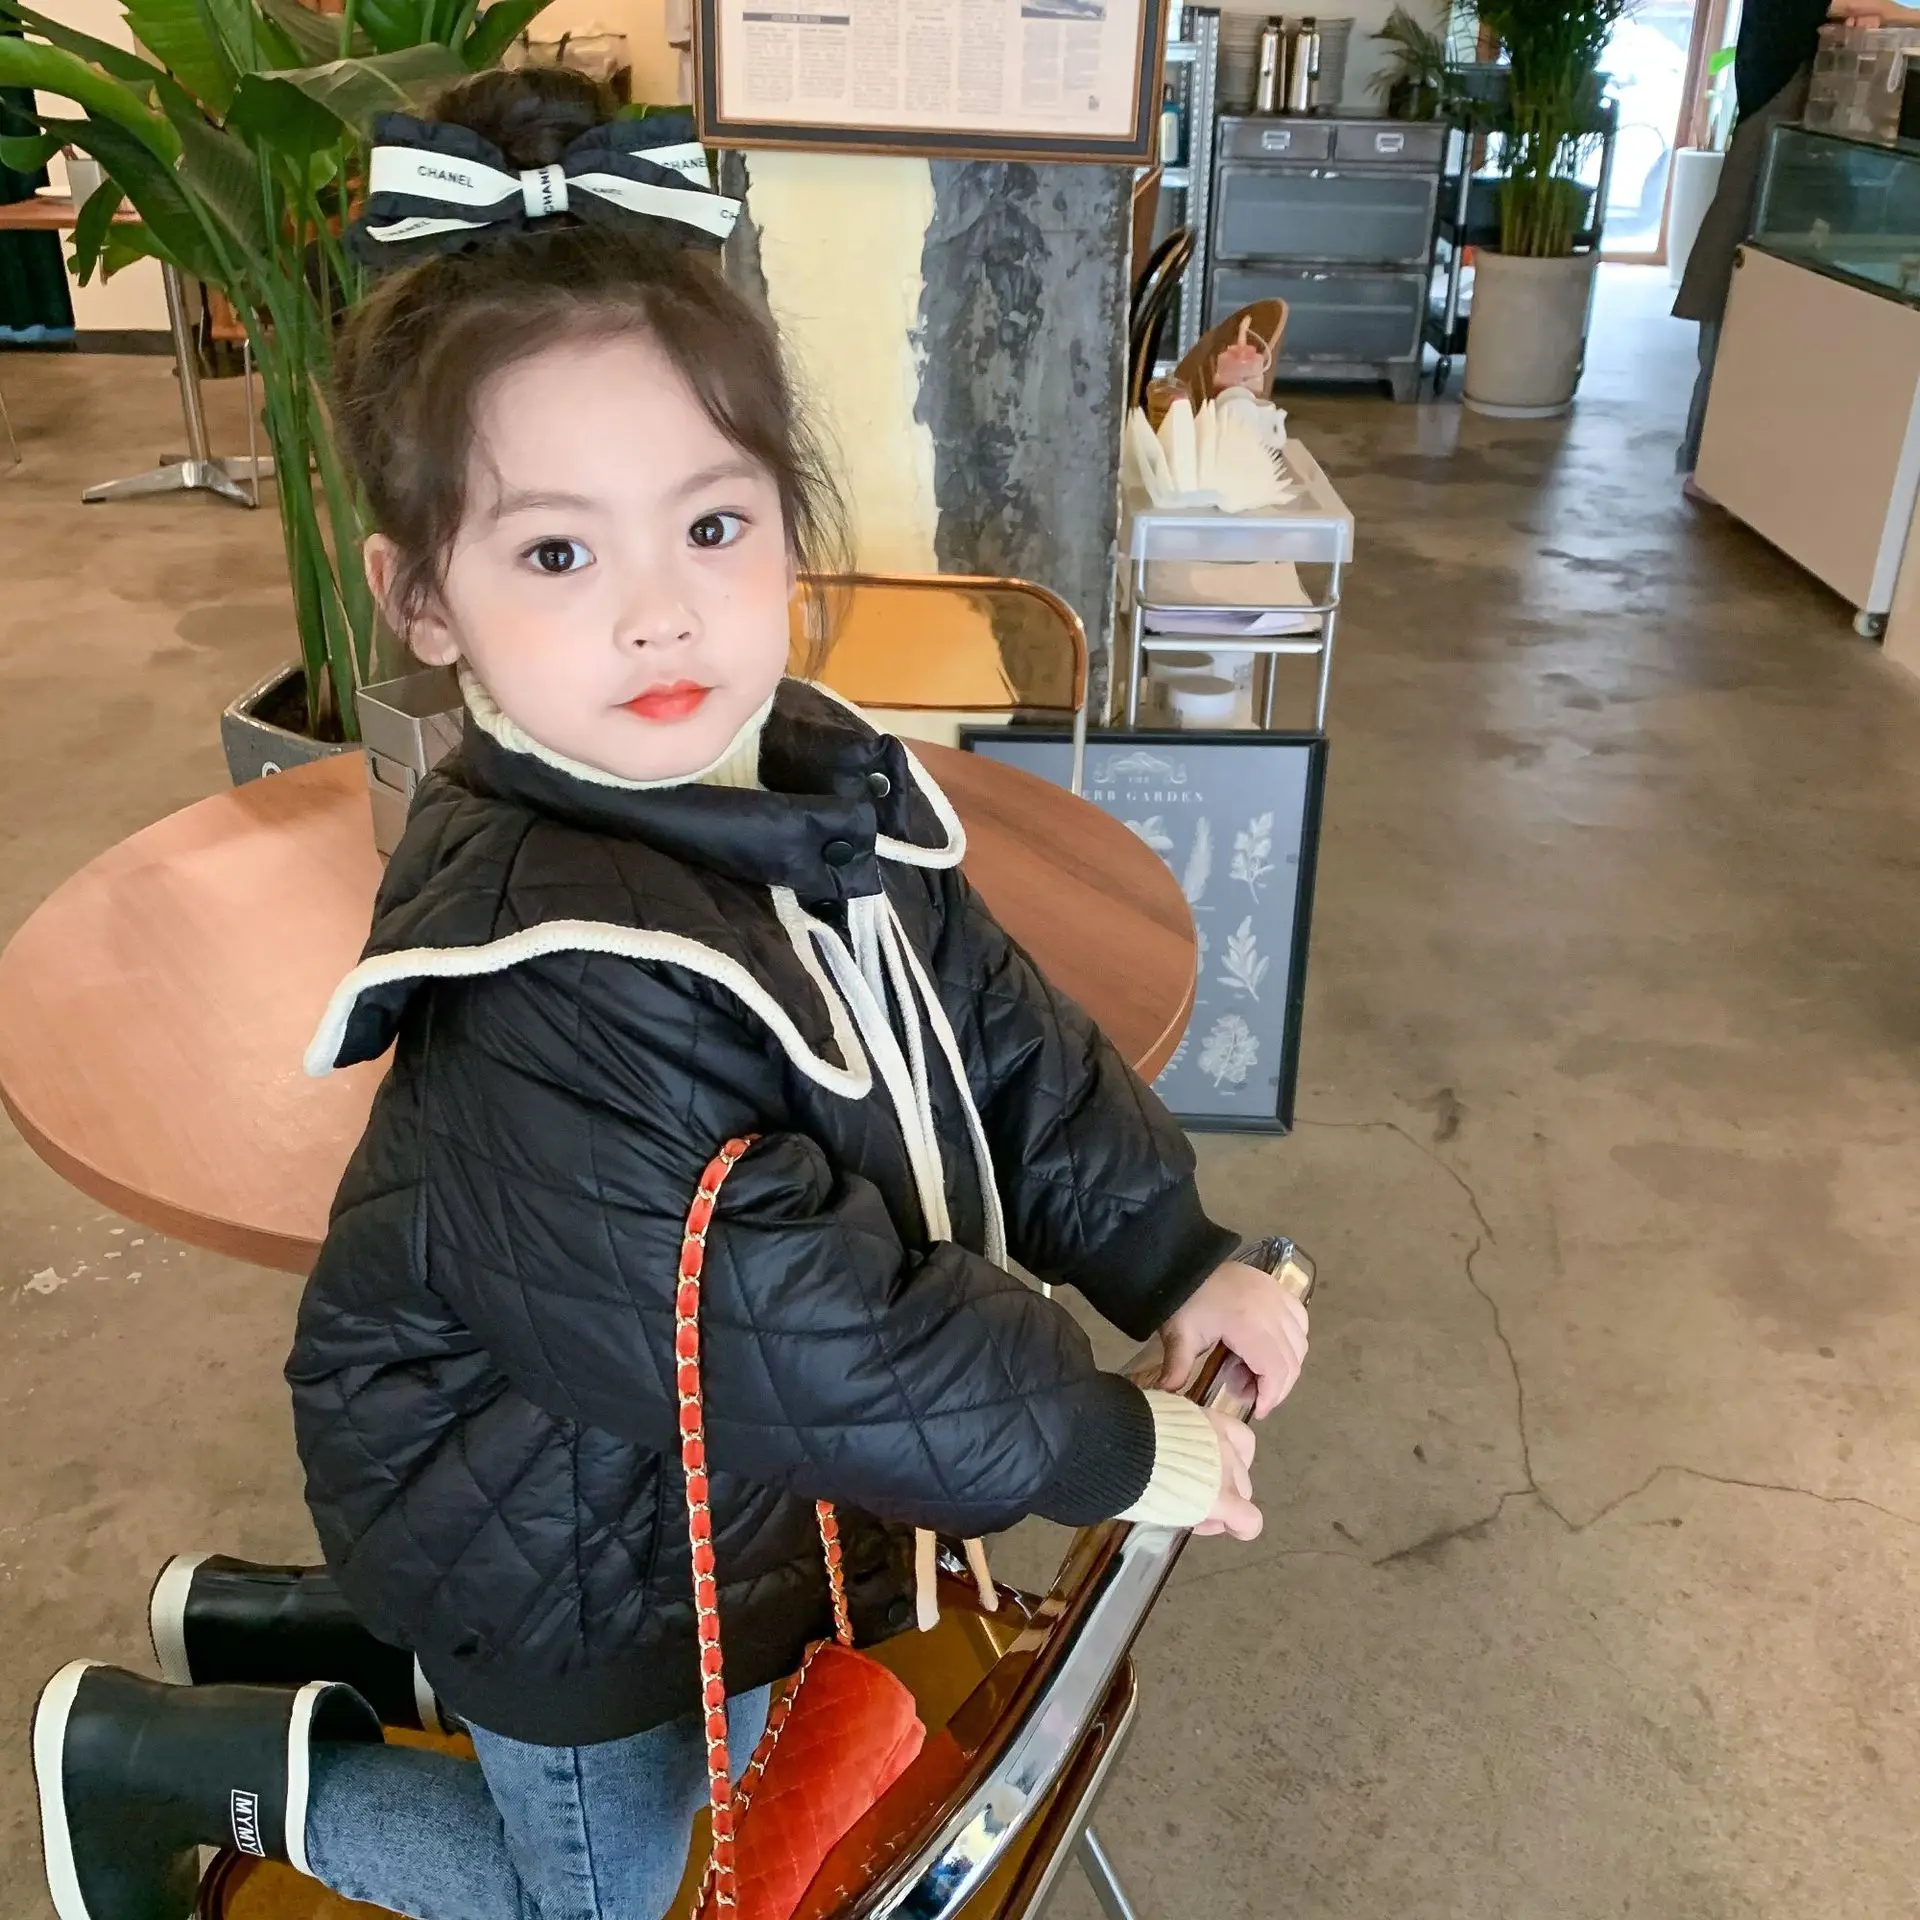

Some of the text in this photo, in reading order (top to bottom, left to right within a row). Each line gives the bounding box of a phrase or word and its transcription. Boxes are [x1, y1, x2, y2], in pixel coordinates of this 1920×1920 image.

[416, 165, 475, 188] CHANEL
[1082, 789, 1203, 802] ERB GARDEN
[235, 1797, 259, 1853] MYMY
